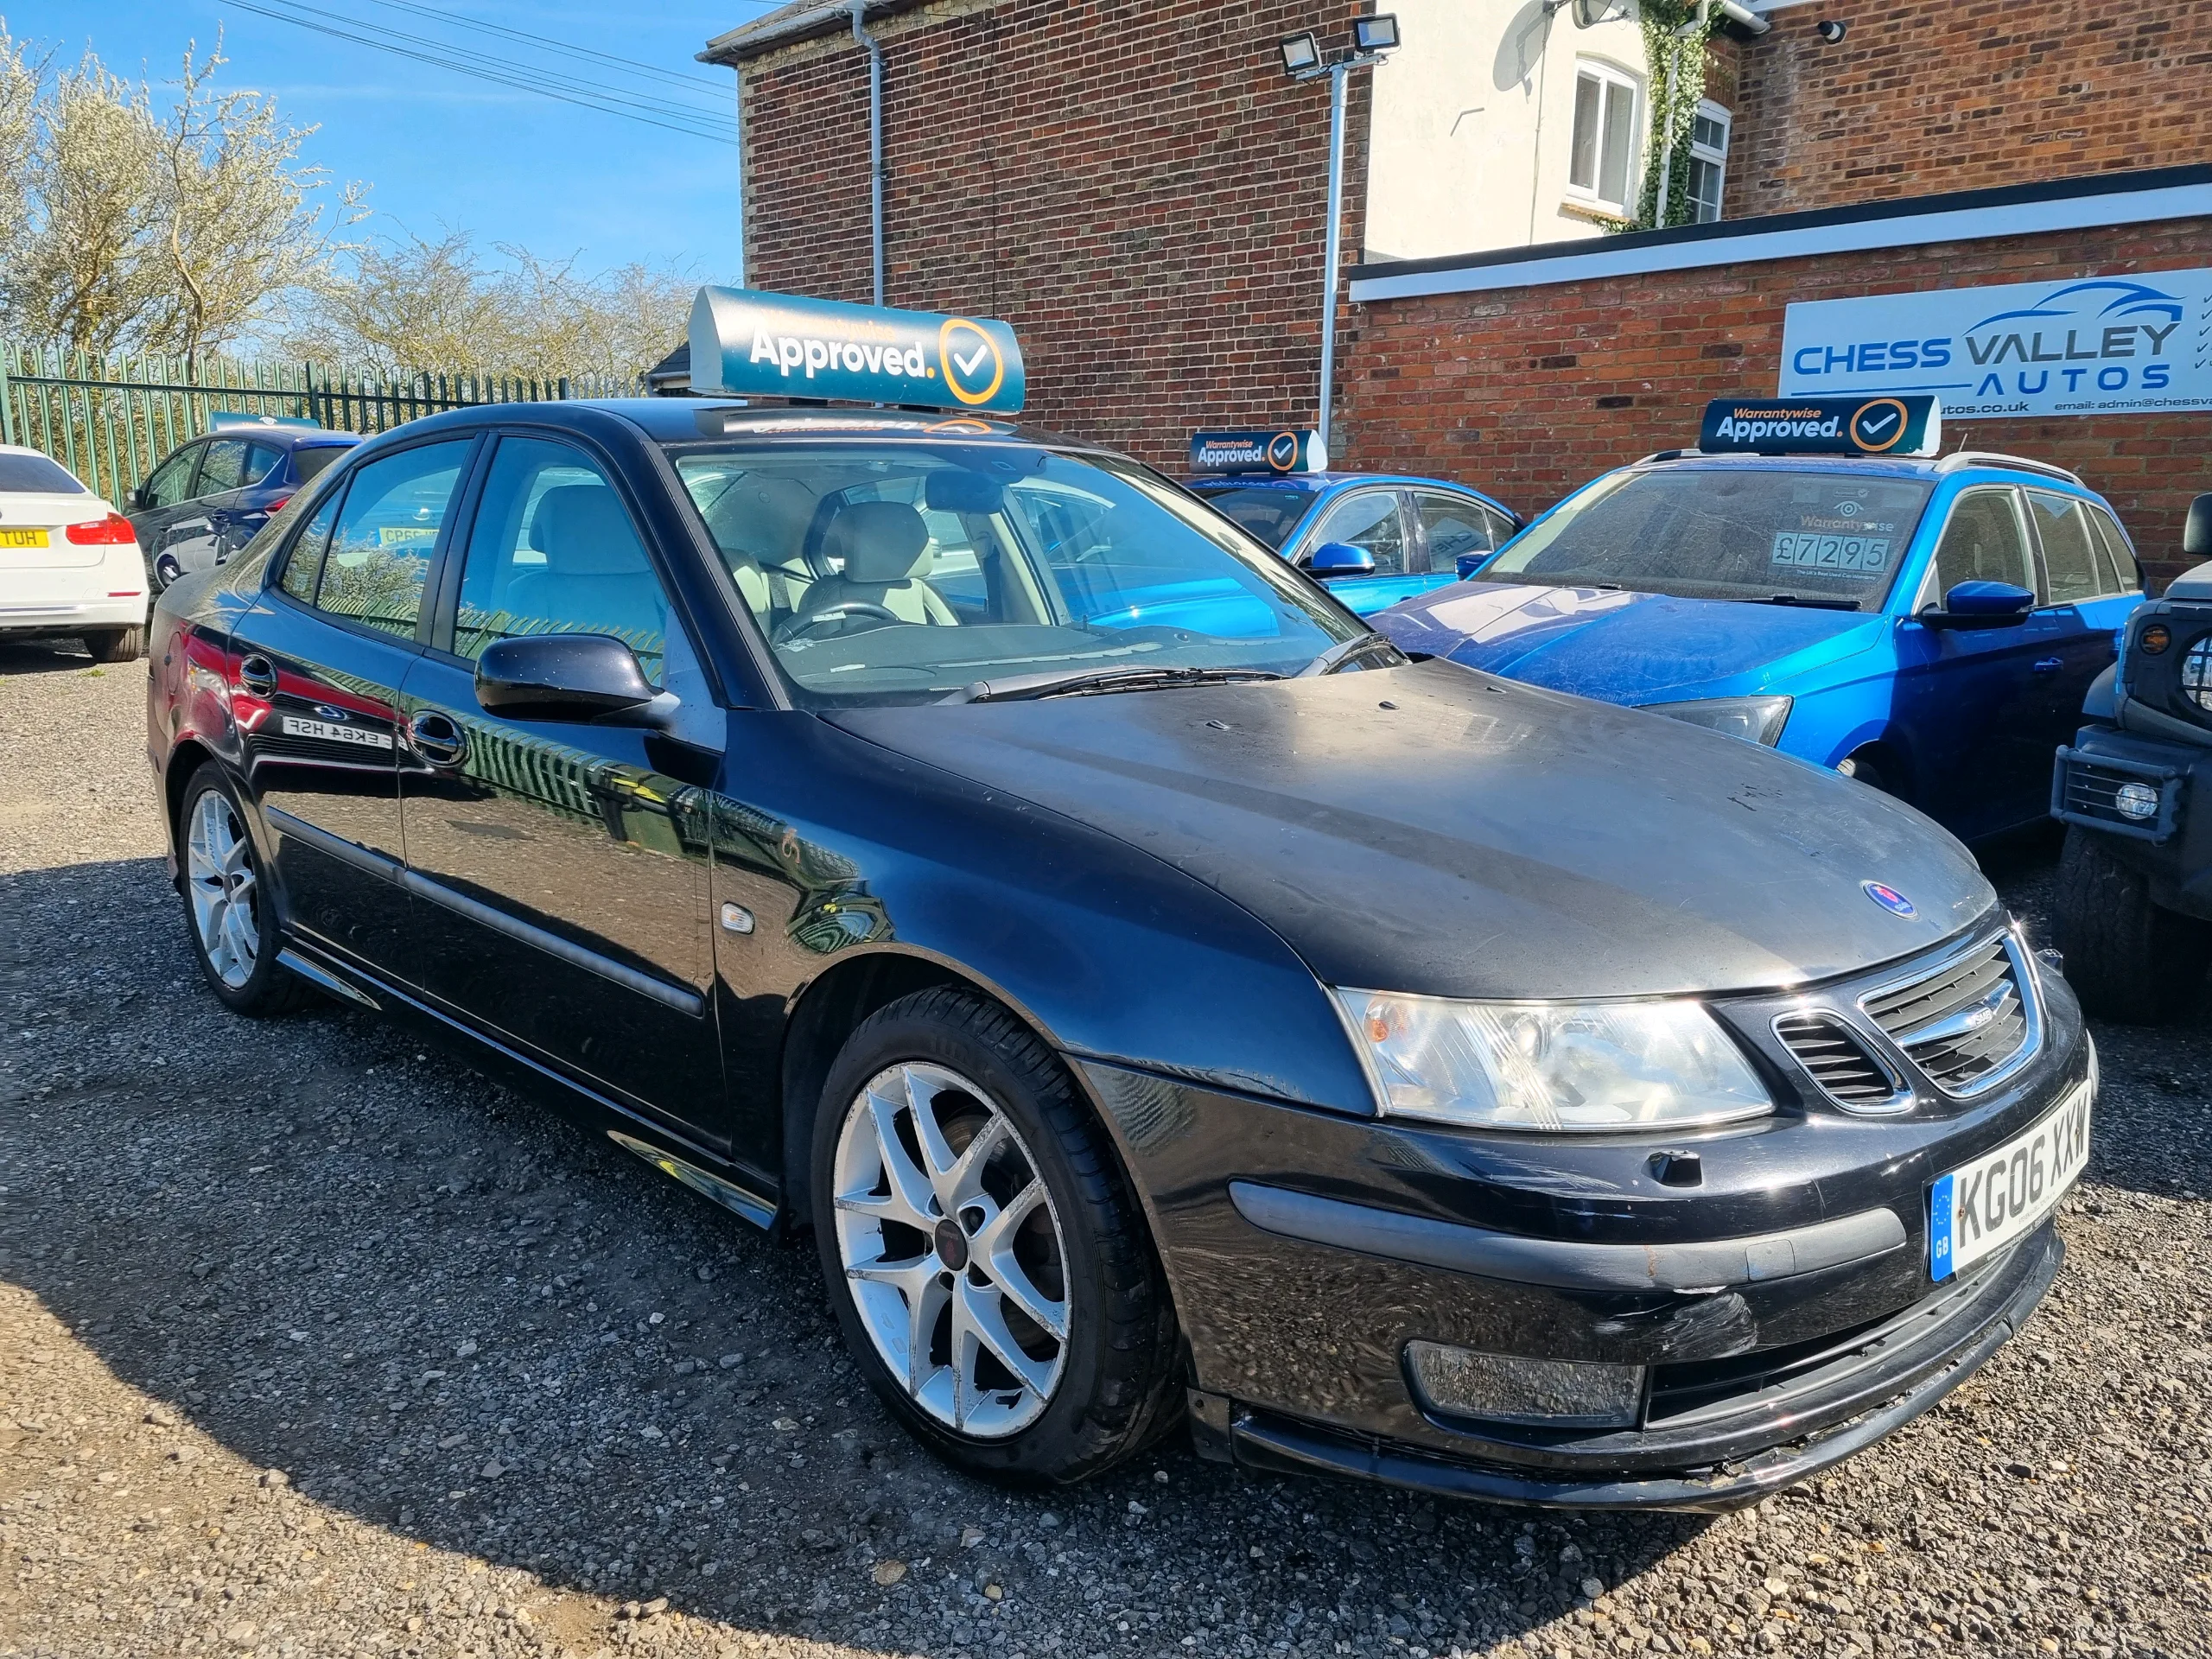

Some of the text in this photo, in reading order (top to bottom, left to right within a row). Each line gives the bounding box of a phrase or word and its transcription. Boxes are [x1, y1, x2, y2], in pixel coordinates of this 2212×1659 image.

[750, 319, 936, 378] Approved.
[1793, 321, 2182, 376] CHESS VALLEY
[1976, 363, 2171, 397] AUTOS
[1733, 408, 1821, 421] Warrantywise
[2055, 400, 2095, 410] email:
[1715, 416, 1843, 443] Approved.
[1198, 445, 1266, 467] Approved.
[1205, 440, 1253, 450] Warrantywise
[1, 531, 37, 545] TUH
[1776, 536, 1885, 567] £7295
[1959, 1134, 2045, 1249] KG06
[2050, 1091, 2088, 1188] XXW
[1936, 1236, 1948, 1259] GB
